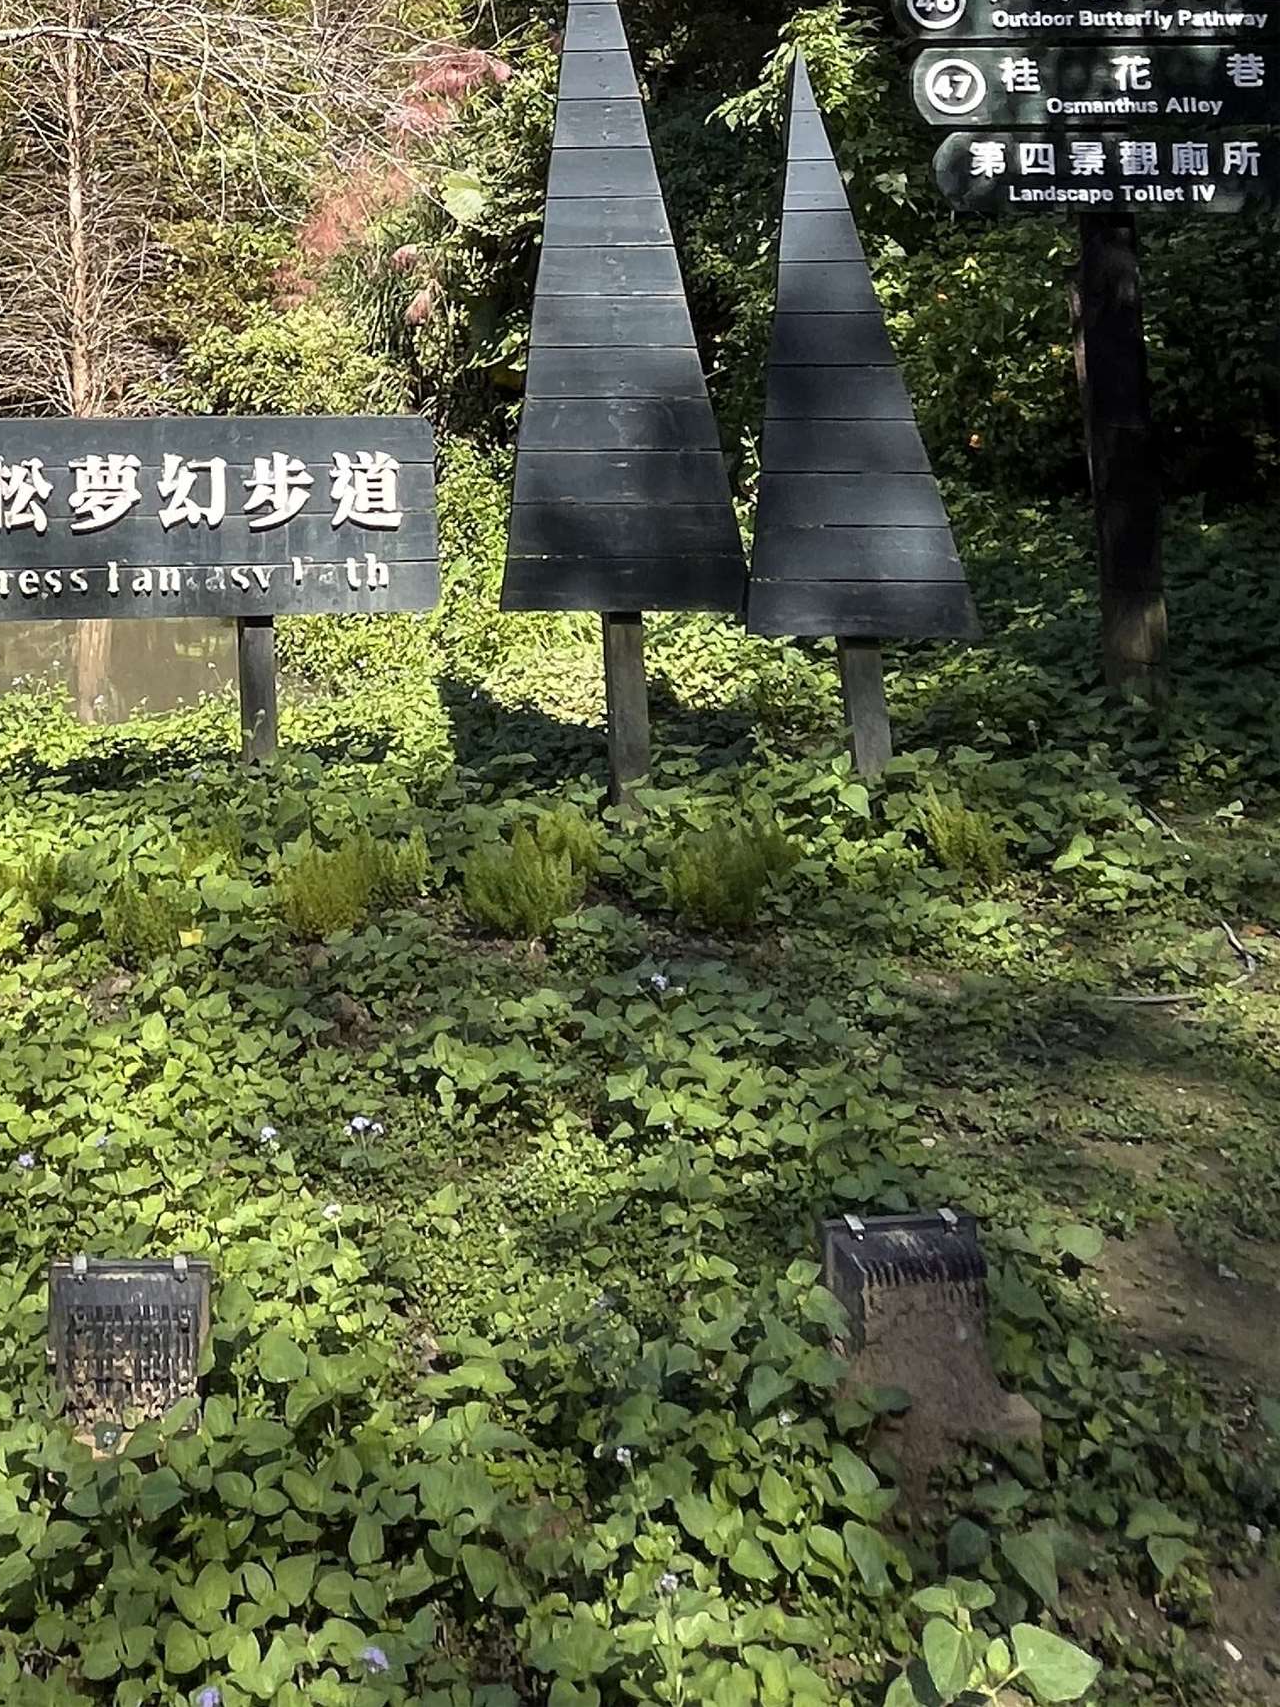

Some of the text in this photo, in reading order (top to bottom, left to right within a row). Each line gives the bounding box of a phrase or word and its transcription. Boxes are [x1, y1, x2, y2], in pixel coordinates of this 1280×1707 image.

[991, 9, 1269, 31] Outdoor Butterfly Pathway
[998, 52, 1267, 93] 桂花巷
[932, 74, 973, 99] 47
[1046, 97, 1224, 116] Osmanthus Alley
[968, 140, 1262, 179] 第四景觀廁所
[1008, 184, 1217, 204] Landscape Toilet IV
[105, 558, 276, 597] anasy
